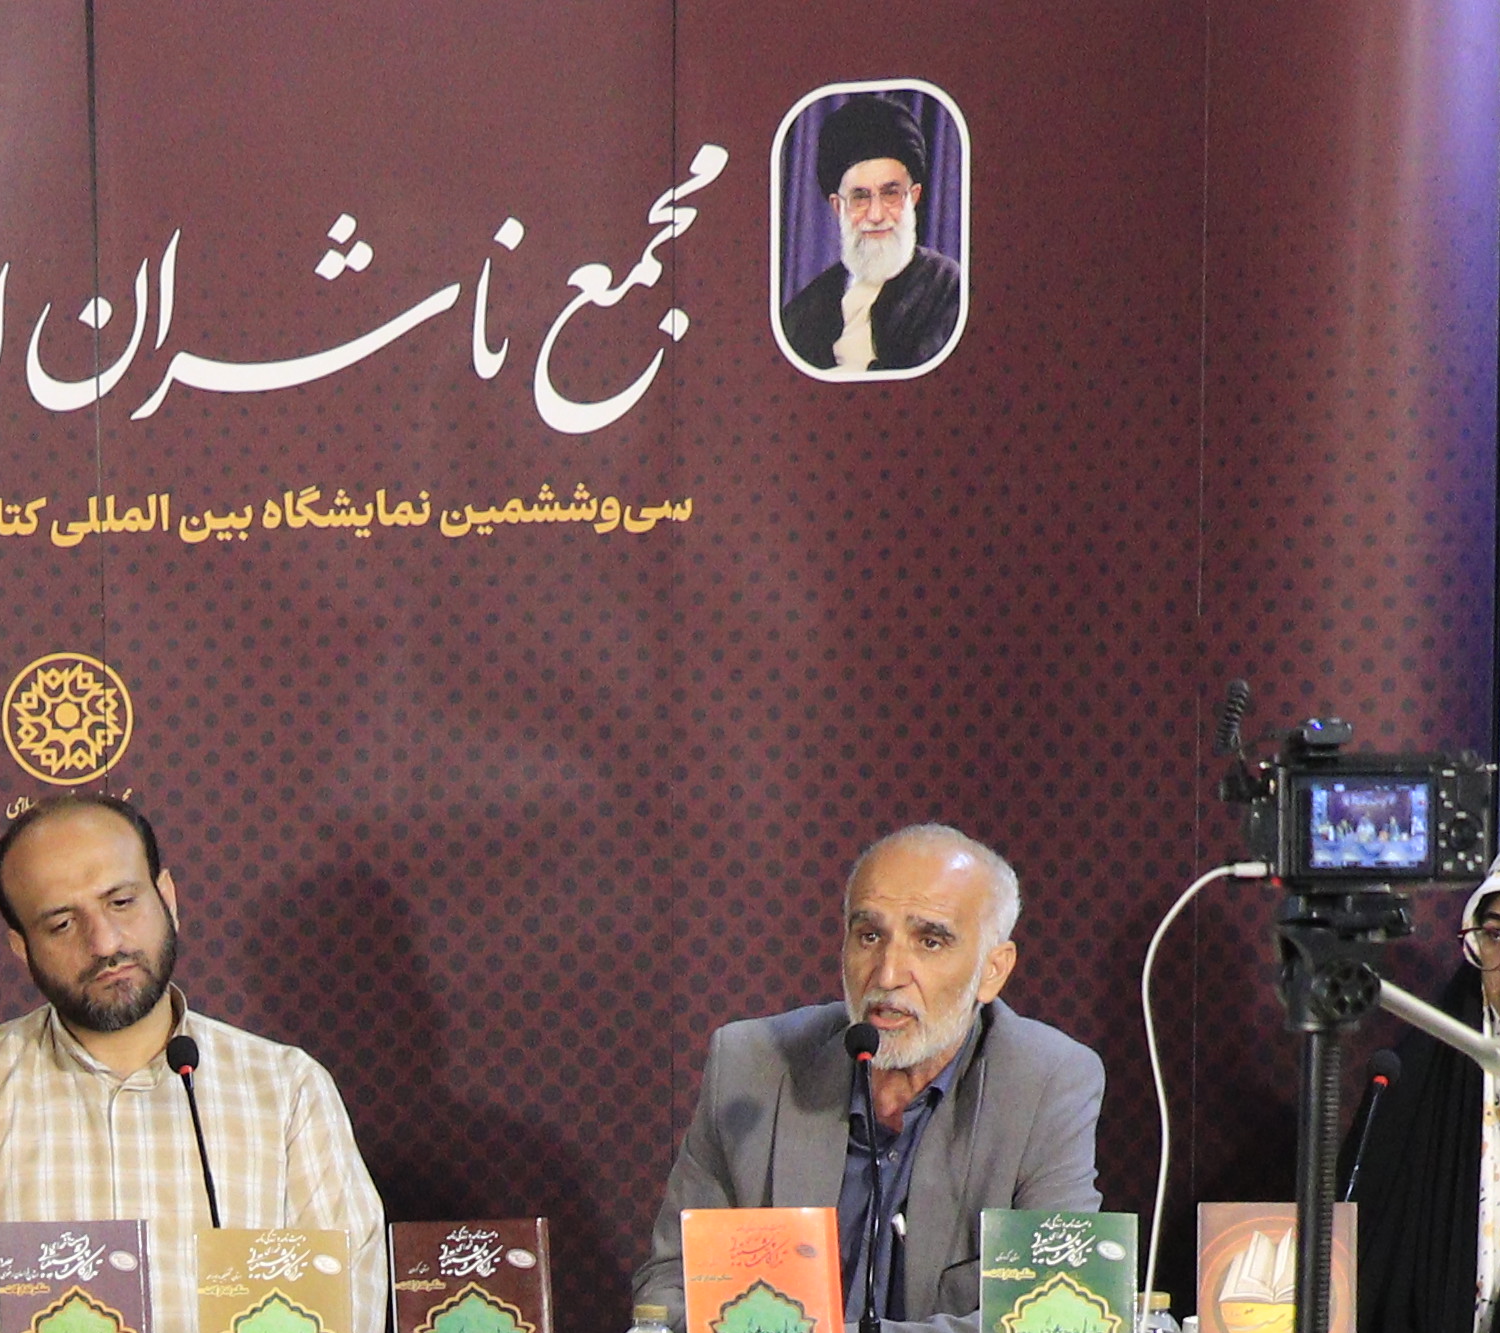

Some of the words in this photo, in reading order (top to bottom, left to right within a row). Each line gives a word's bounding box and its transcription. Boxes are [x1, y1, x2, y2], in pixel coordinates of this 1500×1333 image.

[534, 142, 728, 434] مجمع
[26, 213, 524, 420] ناشران
[50, 493, 171, 547] المللی
[178, 505, 253, 543] بین
[262, 485, 431, 537] نمایشگاه
